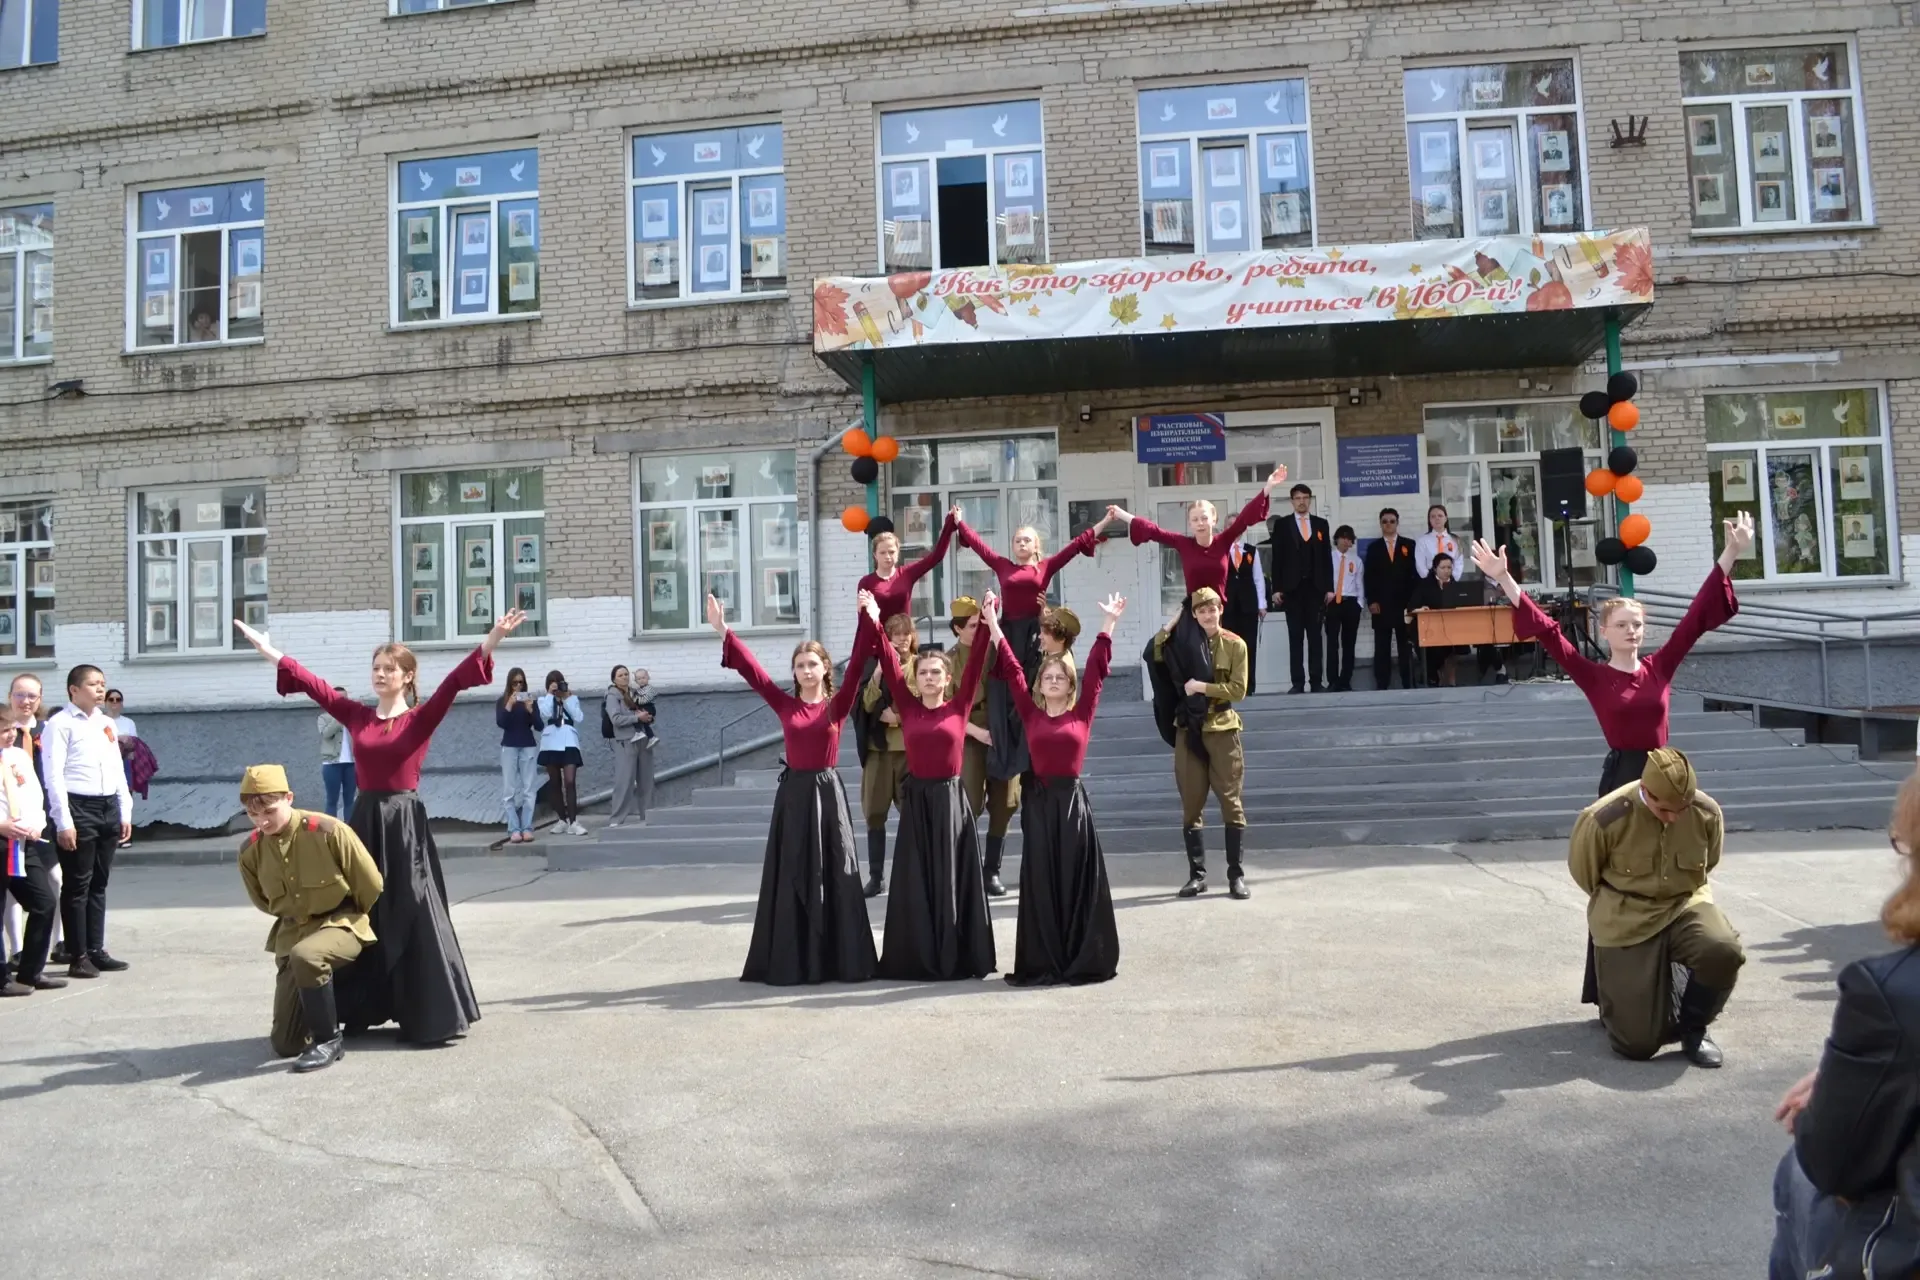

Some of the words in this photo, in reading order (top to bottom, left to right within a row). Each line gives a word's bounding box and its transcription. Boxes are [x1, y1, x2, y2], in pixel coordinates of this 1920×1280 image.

[934, 271, 1002, 296] Как
[1013, 273, 1078, 291] это
[1089, 259, 1232, 294] здорово,
[1242, 255, 1377, 286] ребята,
[1225, 296, 1363, 325] учиться
[1376, 286, 1396, 310] в
[1409, 278, 1523, 308] 160-й!
[1156, 421, 1204, 429] УЧАСТКОВЫЕ
[1150, 428, 1212, 437] ИЗБИРАТЕЛЬНЫЕ
[1161, 436, 1201, 444] КОМИССИИ
[1341, 474, 1417, 483] ОБЩЕОБРАЗОВАТЕЛЬНАЯ
